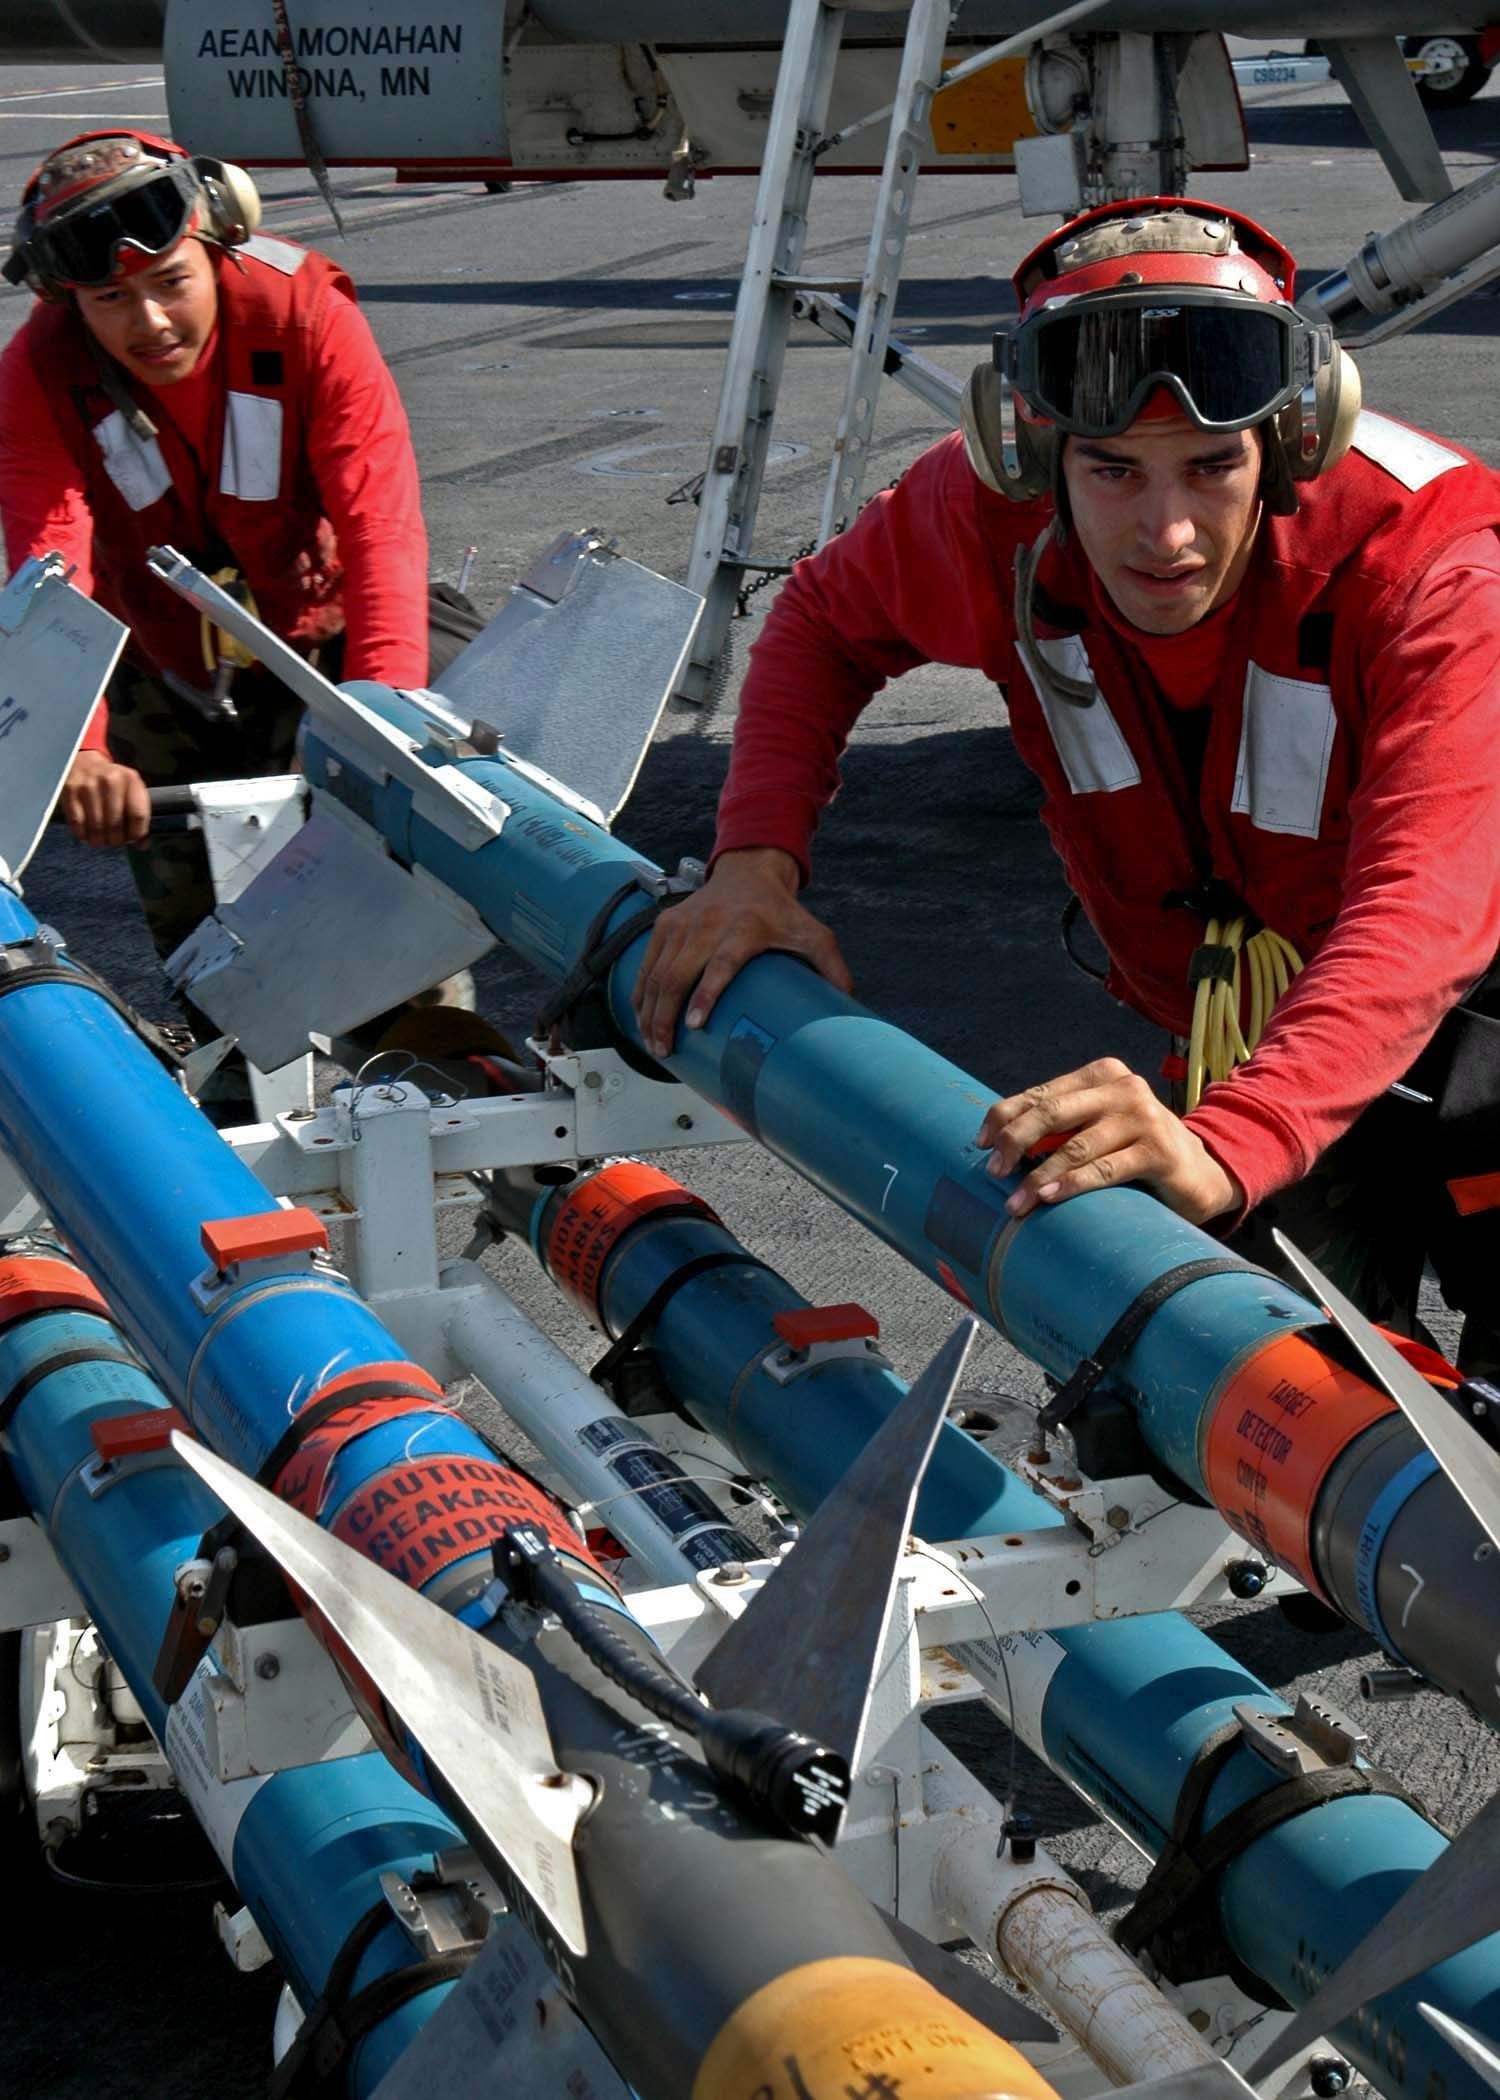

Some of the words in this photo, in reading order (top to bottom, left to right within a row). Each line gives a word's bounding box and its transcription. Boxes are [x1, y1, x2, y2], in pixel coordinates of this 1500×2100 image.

[199, 29, 282, 58] AEAN
[300, 25, 462, 57] MONAHAN
[381, 67, 430, 96] MN
[883, 1163, 899, 1213] 7
[1267, 1378, 1318, 1420] TARGET
[1236, 1409, 1293, 1465] DETECTOR
[348, 1463, 524, 1536] CAUTION
[1235, 1459, 1269, 1501] COVER
